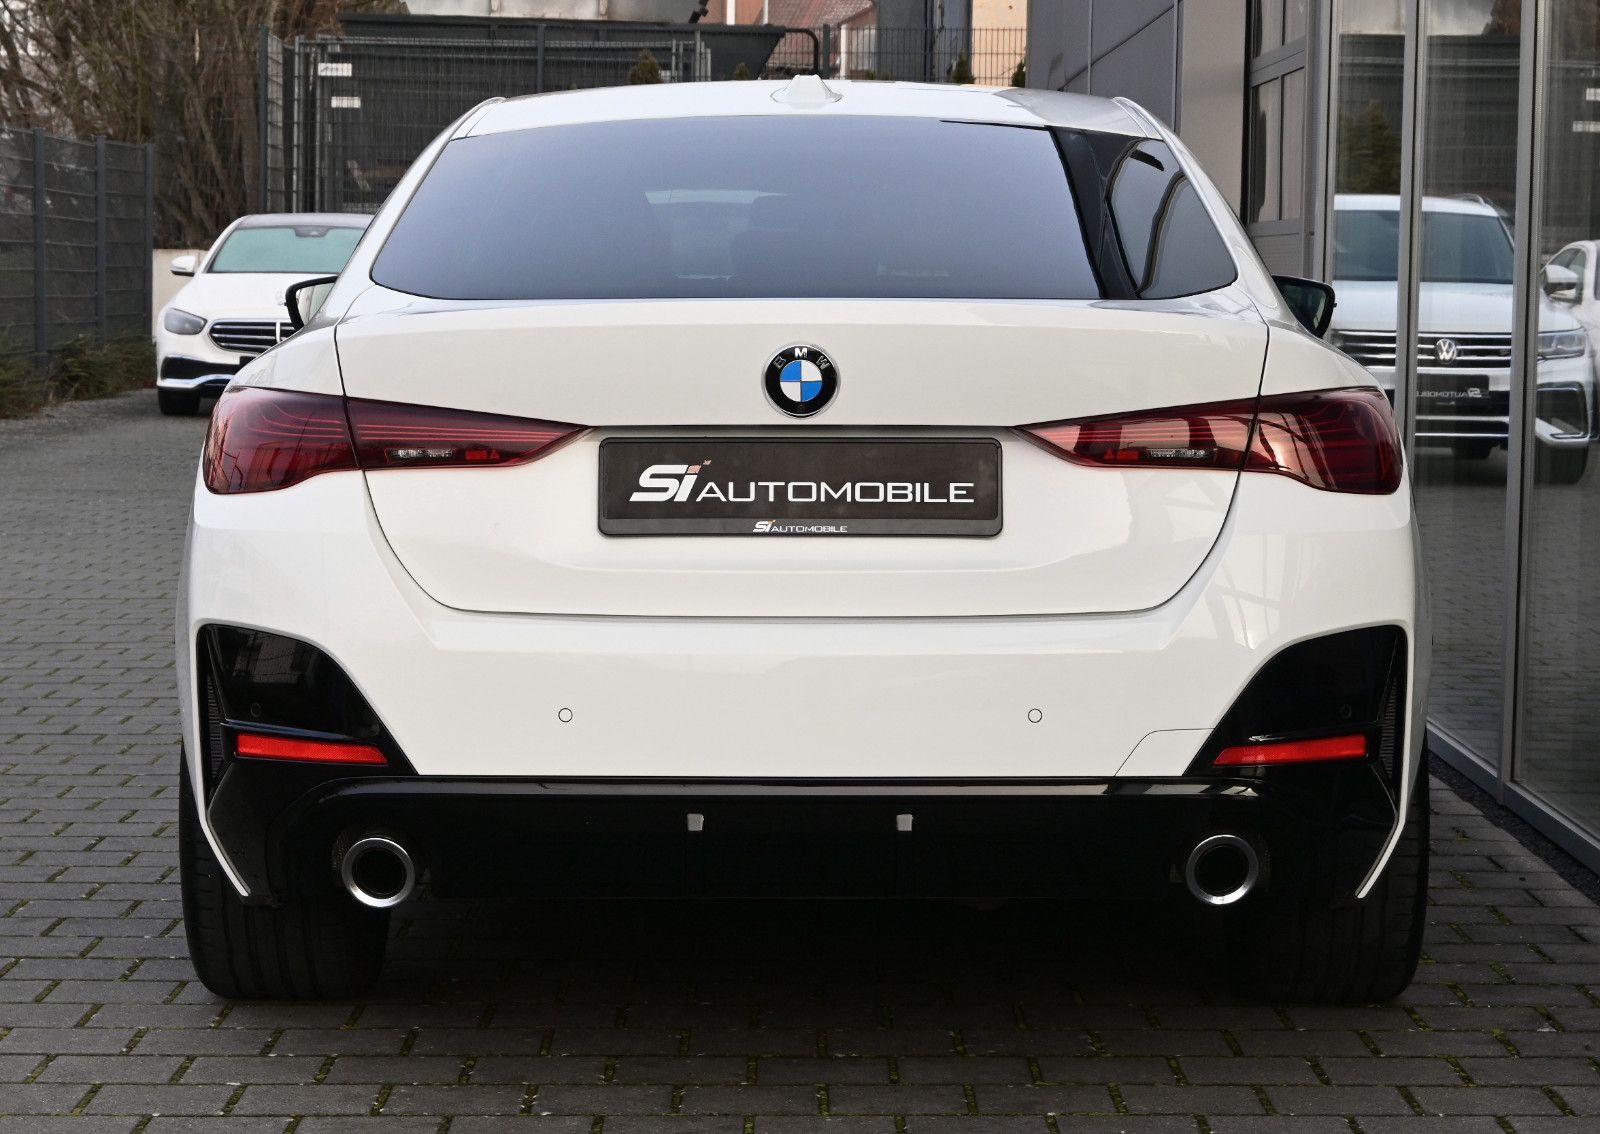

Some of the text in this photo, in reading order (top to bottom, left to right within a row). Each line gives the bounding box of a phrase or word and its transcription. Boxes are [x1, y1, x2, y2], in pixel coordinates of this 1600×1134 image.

[773, 347, 830, 370] BMW
[629, 463, 975, 502] Si AUTOMOBILE
[771, 525, 848, 533] AUTOMOBILE
